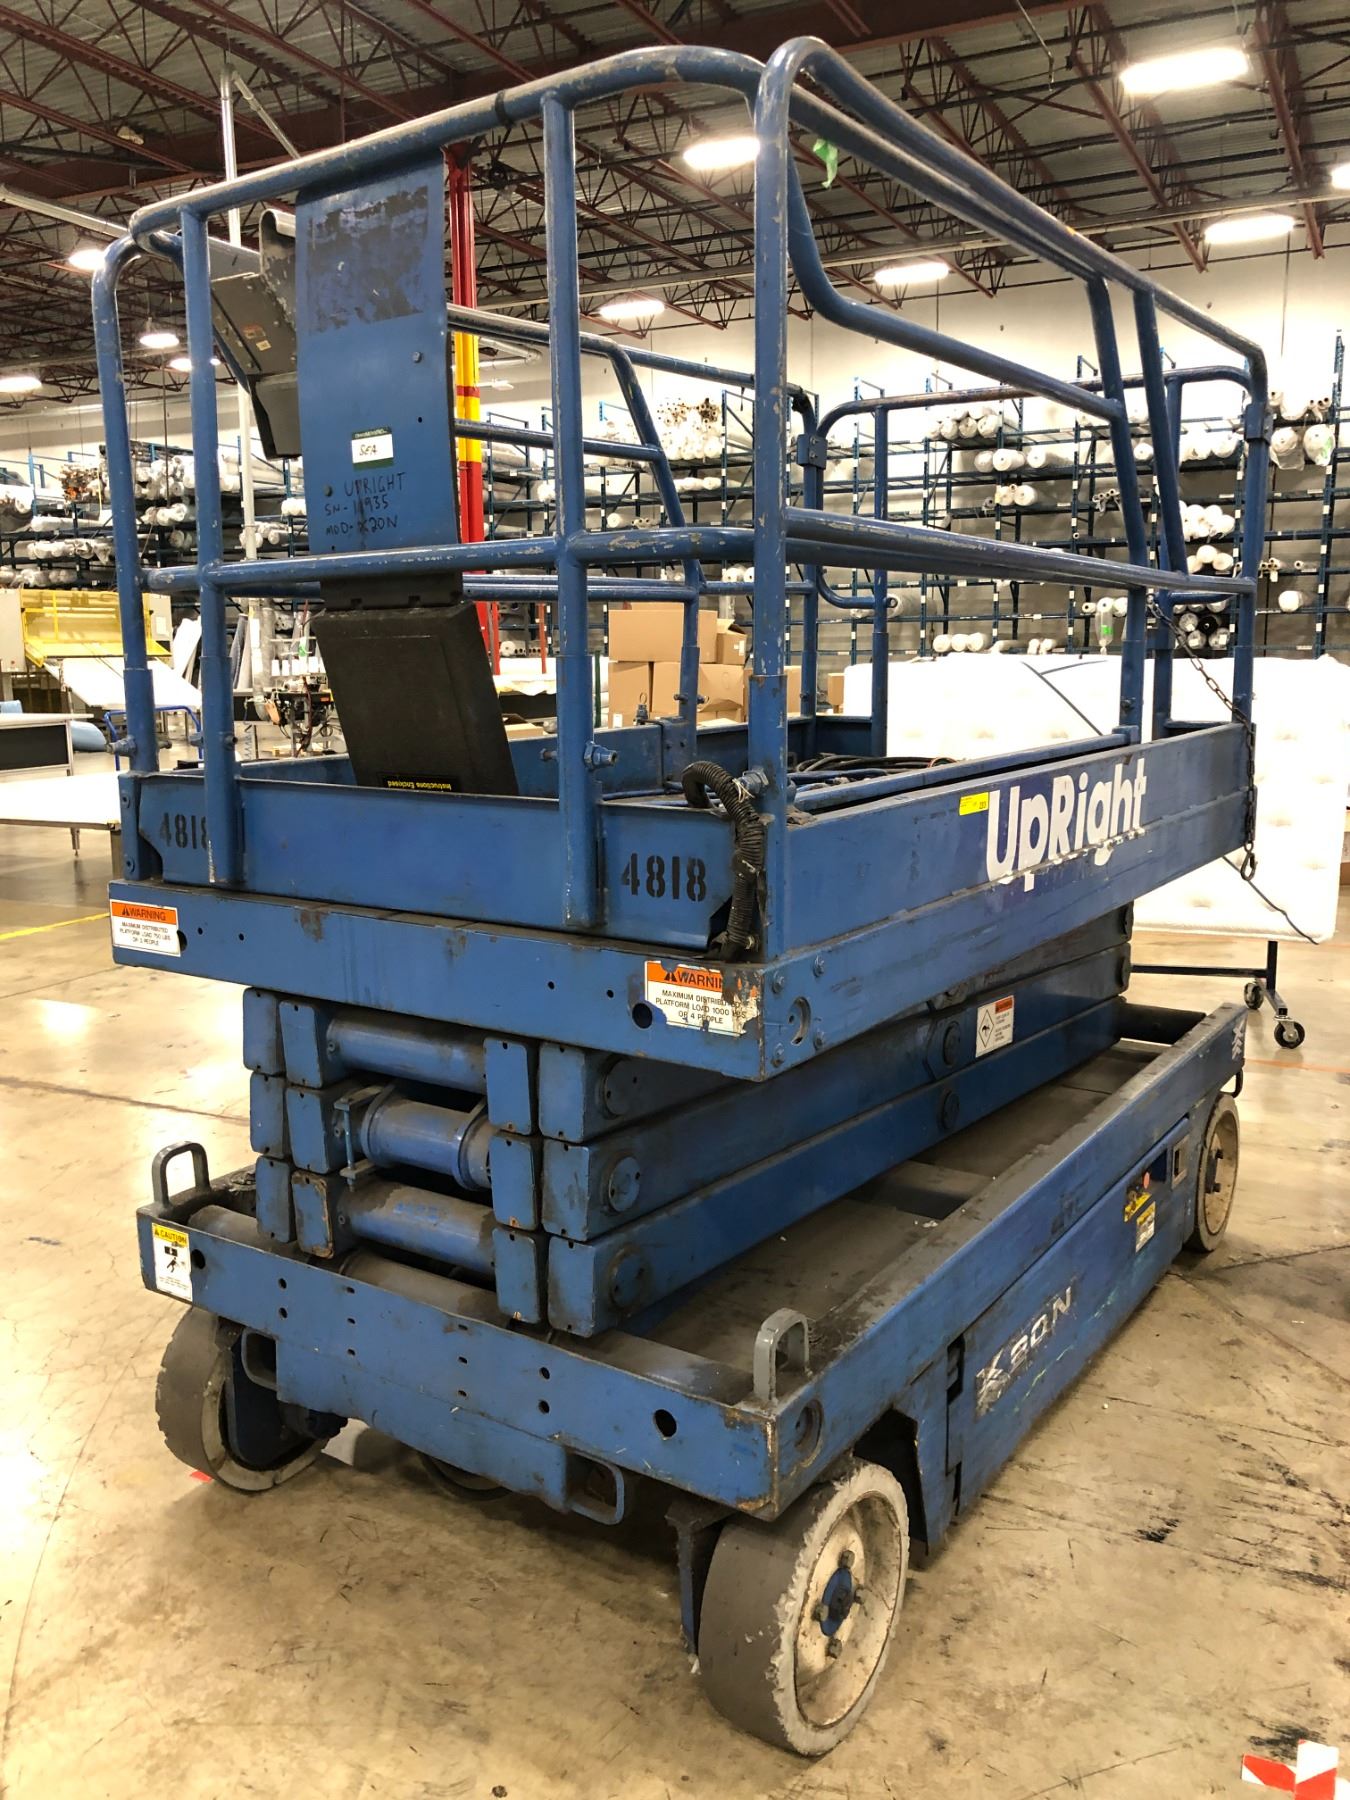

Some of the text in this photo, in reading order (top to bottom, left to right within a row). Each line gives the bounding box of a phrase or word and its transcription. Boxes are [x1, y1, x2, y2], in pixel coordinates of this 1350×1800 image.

[986, 758, 1147, 892] UpRight
[620, 852, 706, 903] 4818
[129, 909, 167, 921] WARNING
[661, 989, 694, 1001] MAXIMUM
[655, 997, 690, 1010] PLATFORM
[692, 1003, 710, 1013] LOAD
[712, 1007, 730, 1017] 1000
[697, 1014, 724, 1024] PEOPLE
[160, 1230, 187, 1243] CAUTION
